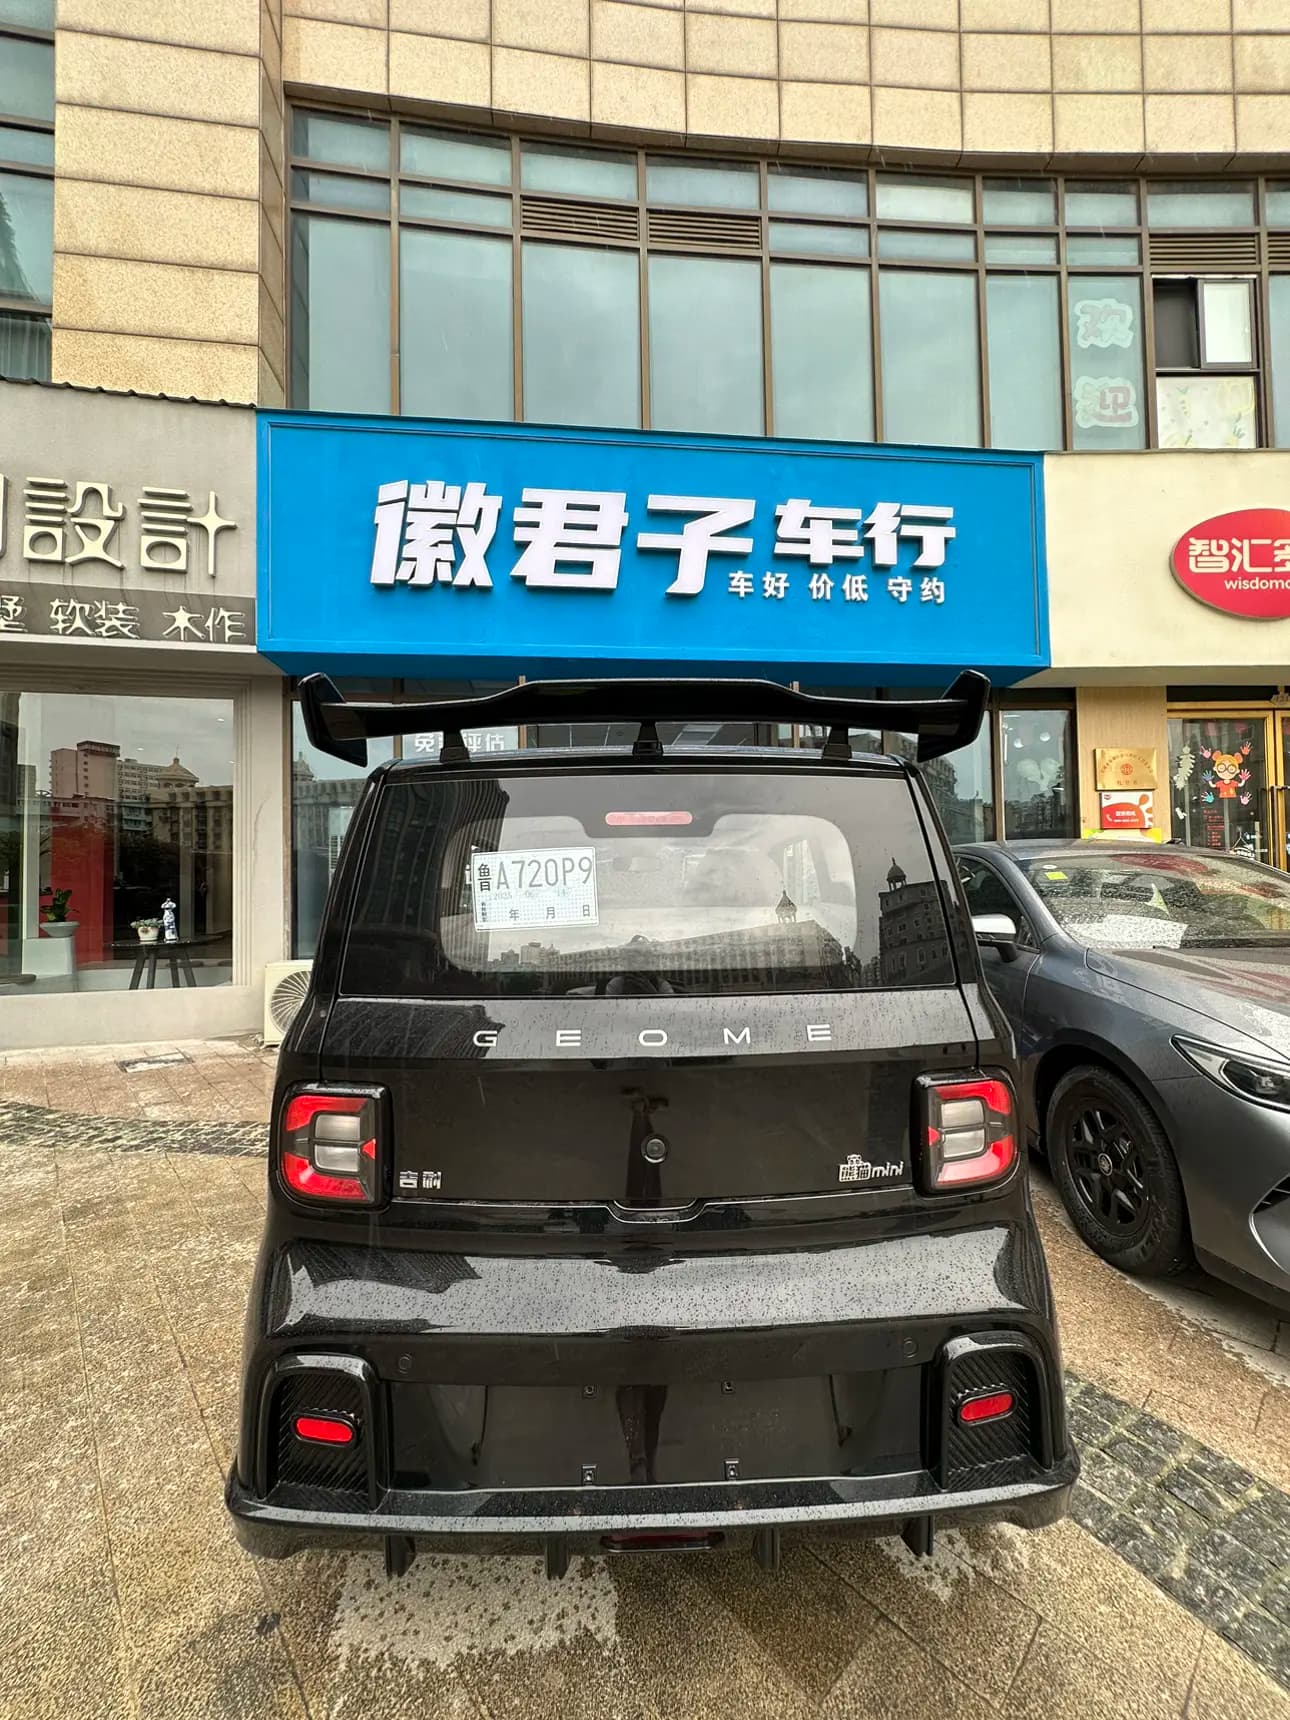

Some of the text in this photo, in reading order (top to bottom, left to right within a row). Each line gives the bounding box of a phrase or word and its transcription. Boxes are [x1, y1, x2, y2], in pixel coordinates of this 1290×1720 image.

[0, 474, 238, 577] 設計
[370, 480, 957, 596] 徽君子车行
[728, 571, 945, 603] 车好 价低 守约
[49, 598, 140, 639] 软装
[162, 606, 246, 642] 木作
[414, 733, 505, 752] 免评估
[545, 906, 556, 919] 月
[582, 904, 591, 917] 日
[473, 1024, 832, 1047] GEOME
